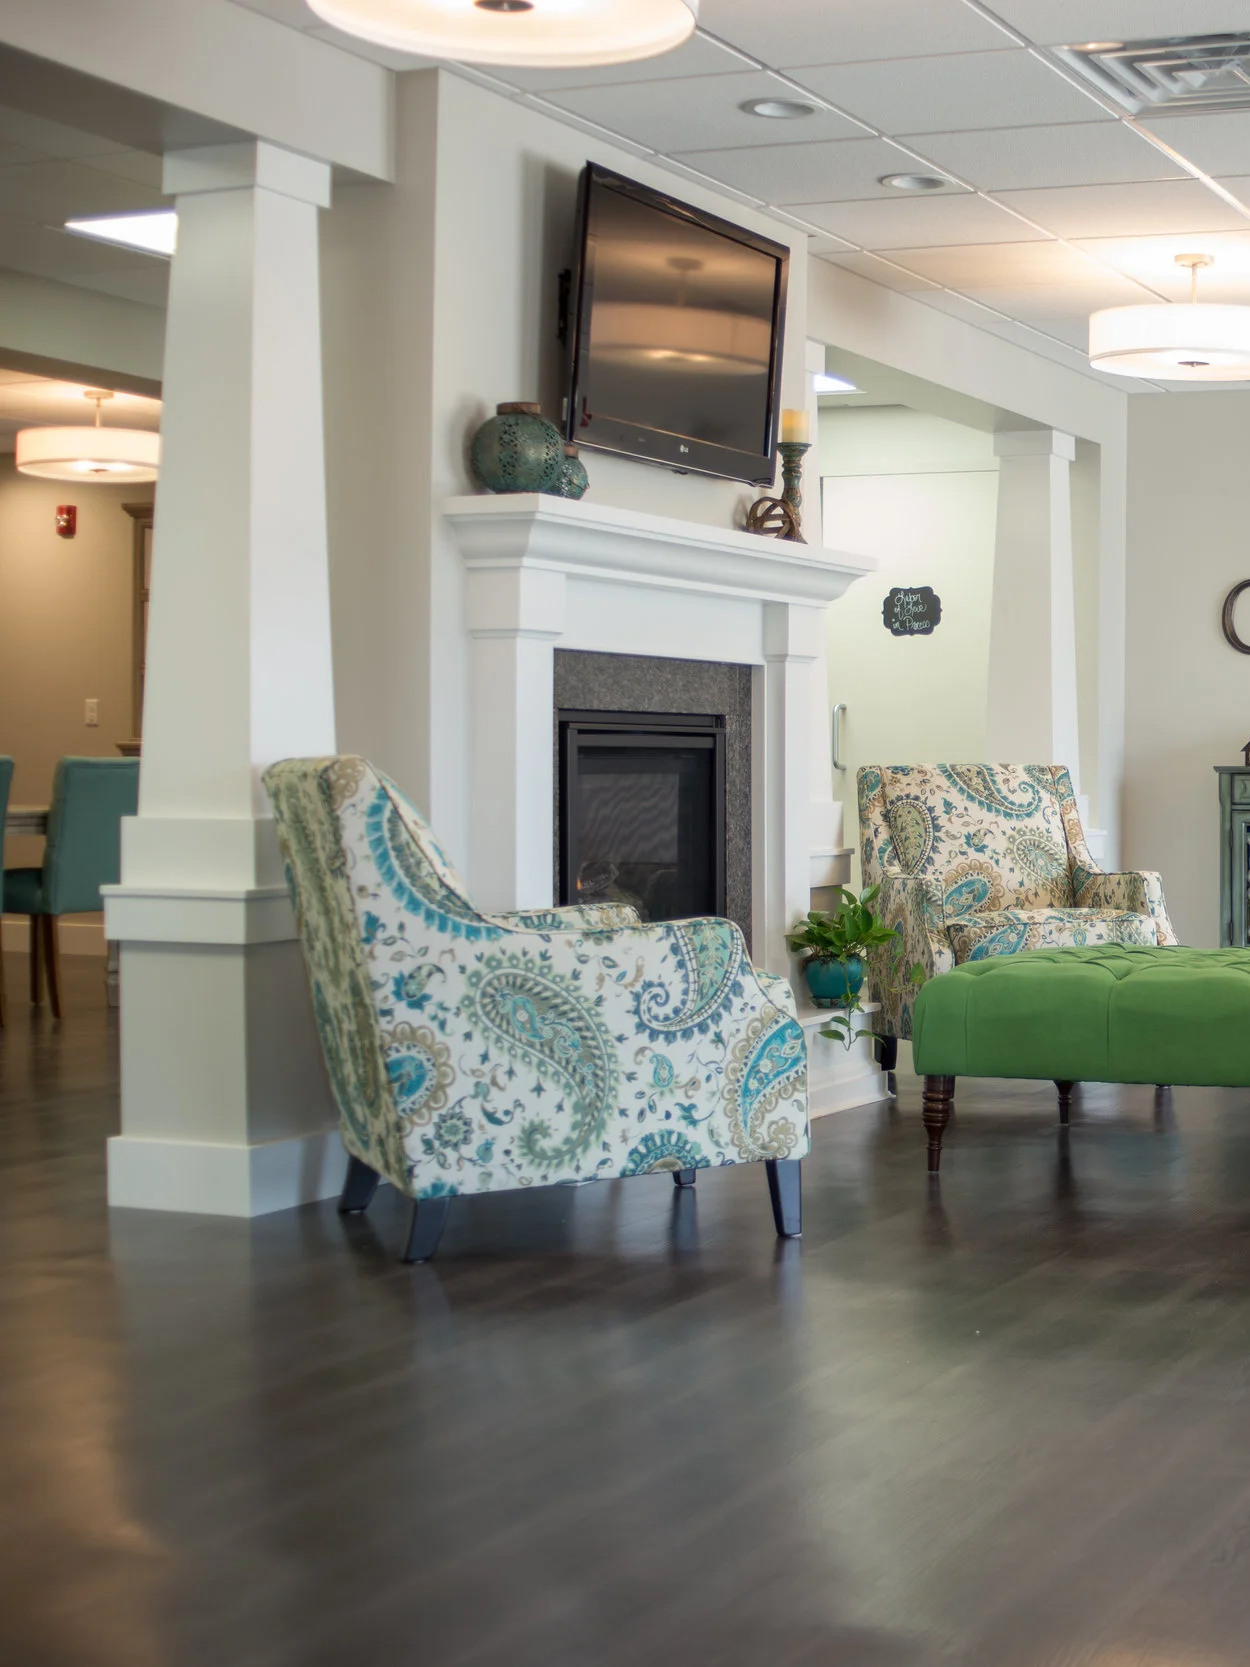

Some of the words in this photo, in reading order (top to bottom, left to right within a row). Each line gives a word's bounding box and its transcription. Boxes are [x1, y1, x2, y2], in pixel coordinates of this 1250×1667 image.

[894, 604, 904, 620] of
[904, 602, 927, 616] Love
[892, 618, 904, 630] in
